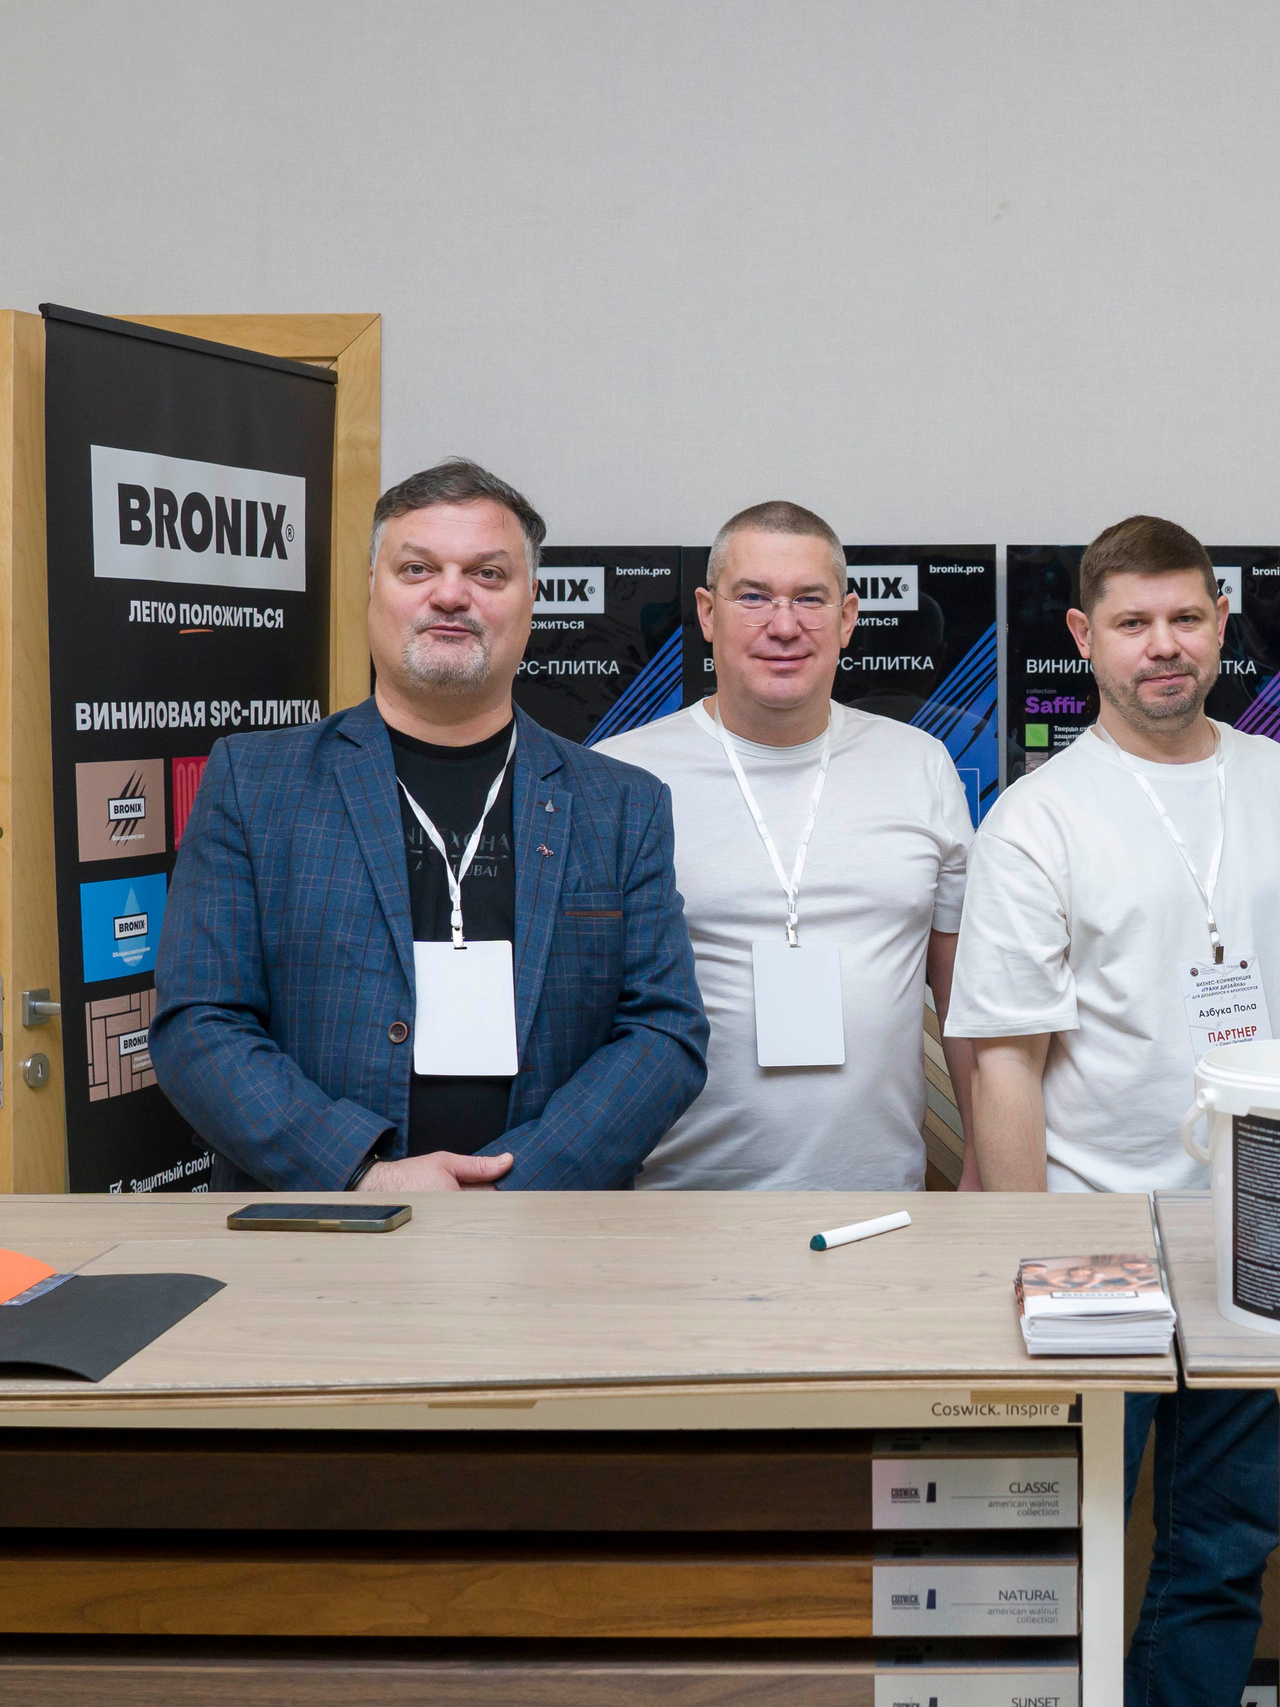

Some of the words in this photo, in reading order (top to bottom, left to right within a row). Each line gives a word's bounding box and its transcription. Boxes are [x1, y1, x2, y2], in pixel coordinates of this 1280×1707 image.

[615, 566, 671, 578] bronix.pro
[929, 564, 985, 575] bronix.pro
[535, 579, 596, 602] NIX®
[847, 577, 909, 600] NIX®
[129, 600, 176, 624] ЛЕГКО
[179, 603, 283, 629] ПОЛОЖИТЬСЯ
[531, 620, 585, 630] ОЖИТЬСЯ
[517, 660, 620, 675] PC-ПЛИТКА
[1026, 659, 1094, 674] ВИНИЛ
[1025, 696, 1086, 714] Saffir
[75, 701, 206, 731] ВИНИЛОВАЯ
[210, 700, 321, 727] SPC-ПЛИТКА
[1053, 725, 1079, 733] Твердо
[113, 803, 142, 815] BRONIX
[118, 919, 145, 933] BRONIX
[1199, 1007, 1231, 1018] Азбука
[1234, 1003, 1257, 1012] Пола
[1208, 1025, 1257, 1043] ПАРТНЕР
[130, 1160, 184, 1193] Защитный
[184, 1151, 210, 1176] слой
[932, 1402, 1000, 1416] Coswick.
[1006, 1403, 1060, 1419] Inspire
[1009, 1482, 1060, 1494] CLASSIC
[988, 1500, 1028, 1508] american
[1029, 1499, 1059, 1508] walnut
[1017, 1507, 1059, 1516] collection
[998, 1590, 1058, 1601] NATURAL
[988, 1607, 1027, 1615] american
[1028, 1606, 1058, 1615] walnut
[1016, 1615, 1059, 1624] collection
[1011, 1697, 1060, 1707] SUNSET
